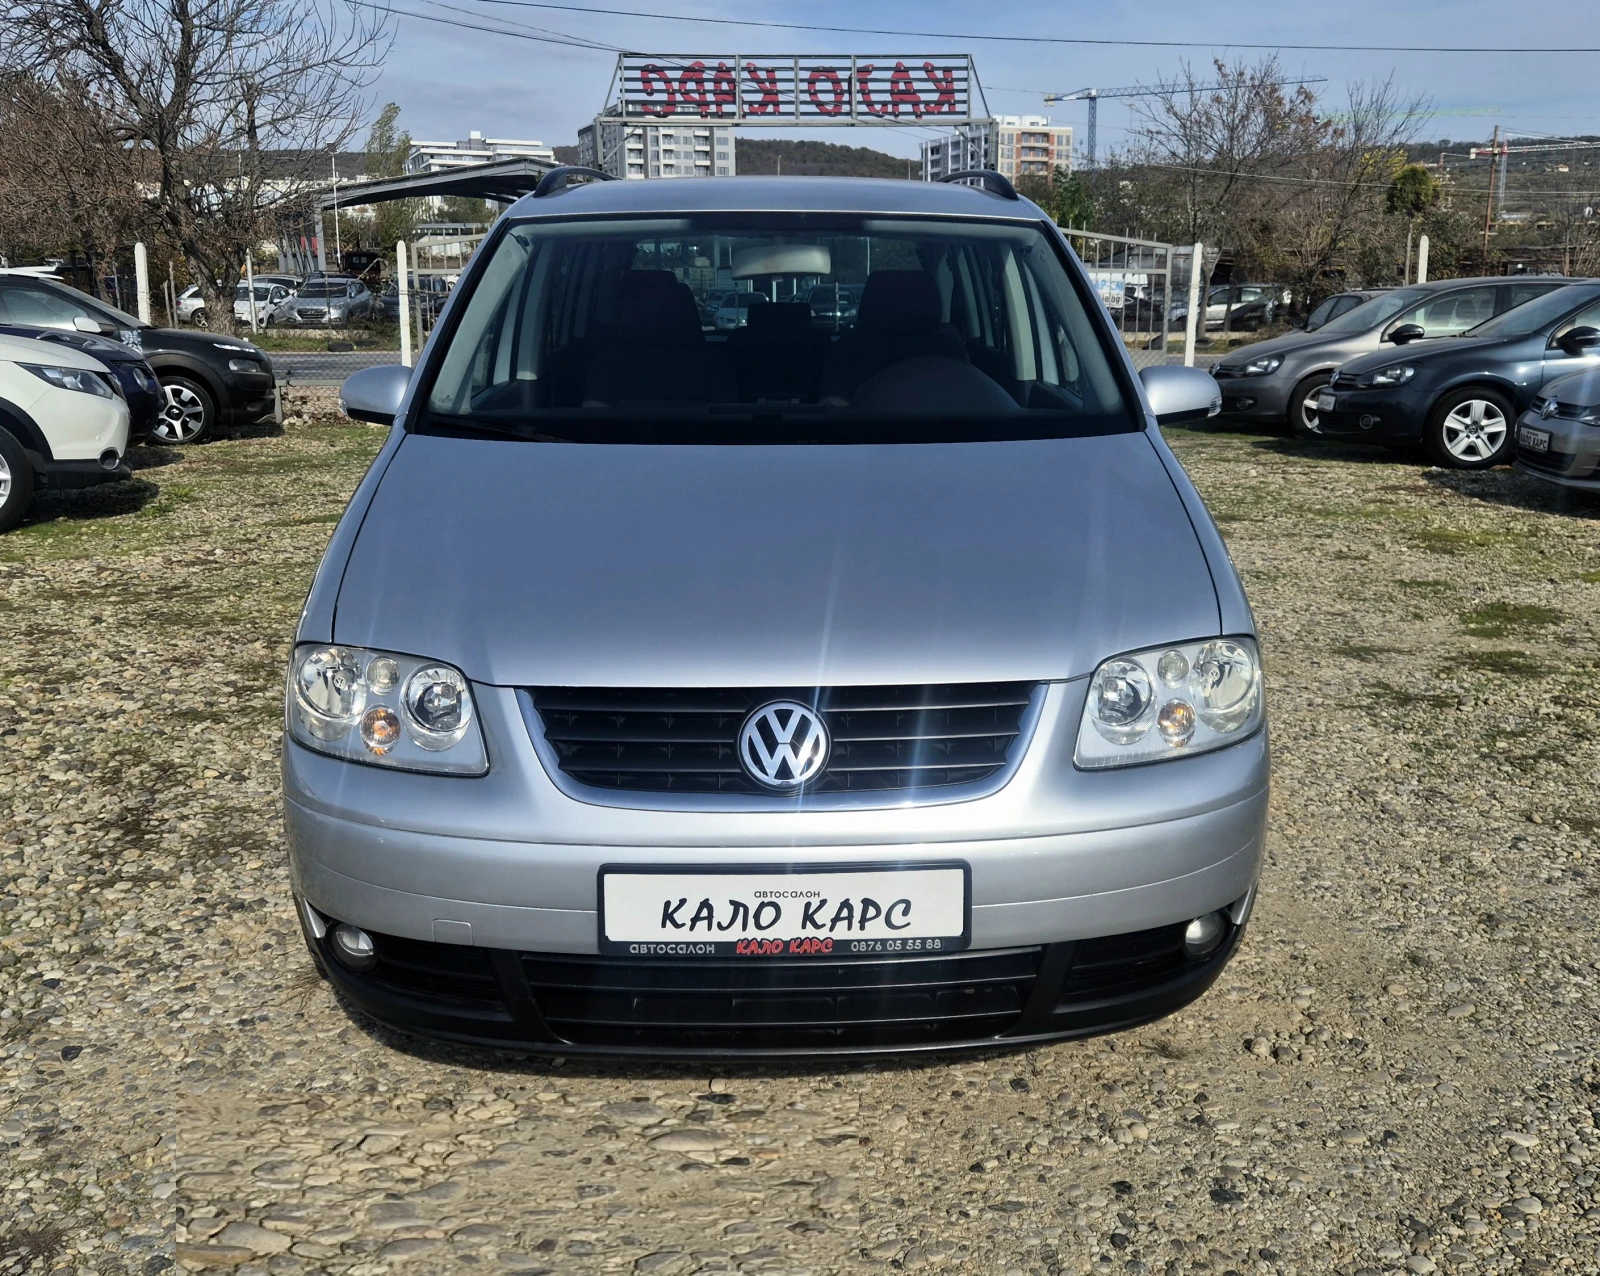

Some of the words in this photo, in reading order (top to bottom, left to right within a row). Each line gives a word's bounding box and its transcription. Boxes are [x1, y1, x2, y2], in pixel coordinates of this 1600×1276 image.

[660, 897, 782, 932] КАЛО
[801, 897, 912, 932] КАРС
[735, 938, 784, 955] КАЛО
[789, 937, 834, 954] КАРС
[850, 941, 883, 952] 0876
[886, 940, 902, 951] 05
[906, 939, 922, 950] 55
[925, 938, 942, 949] 88
